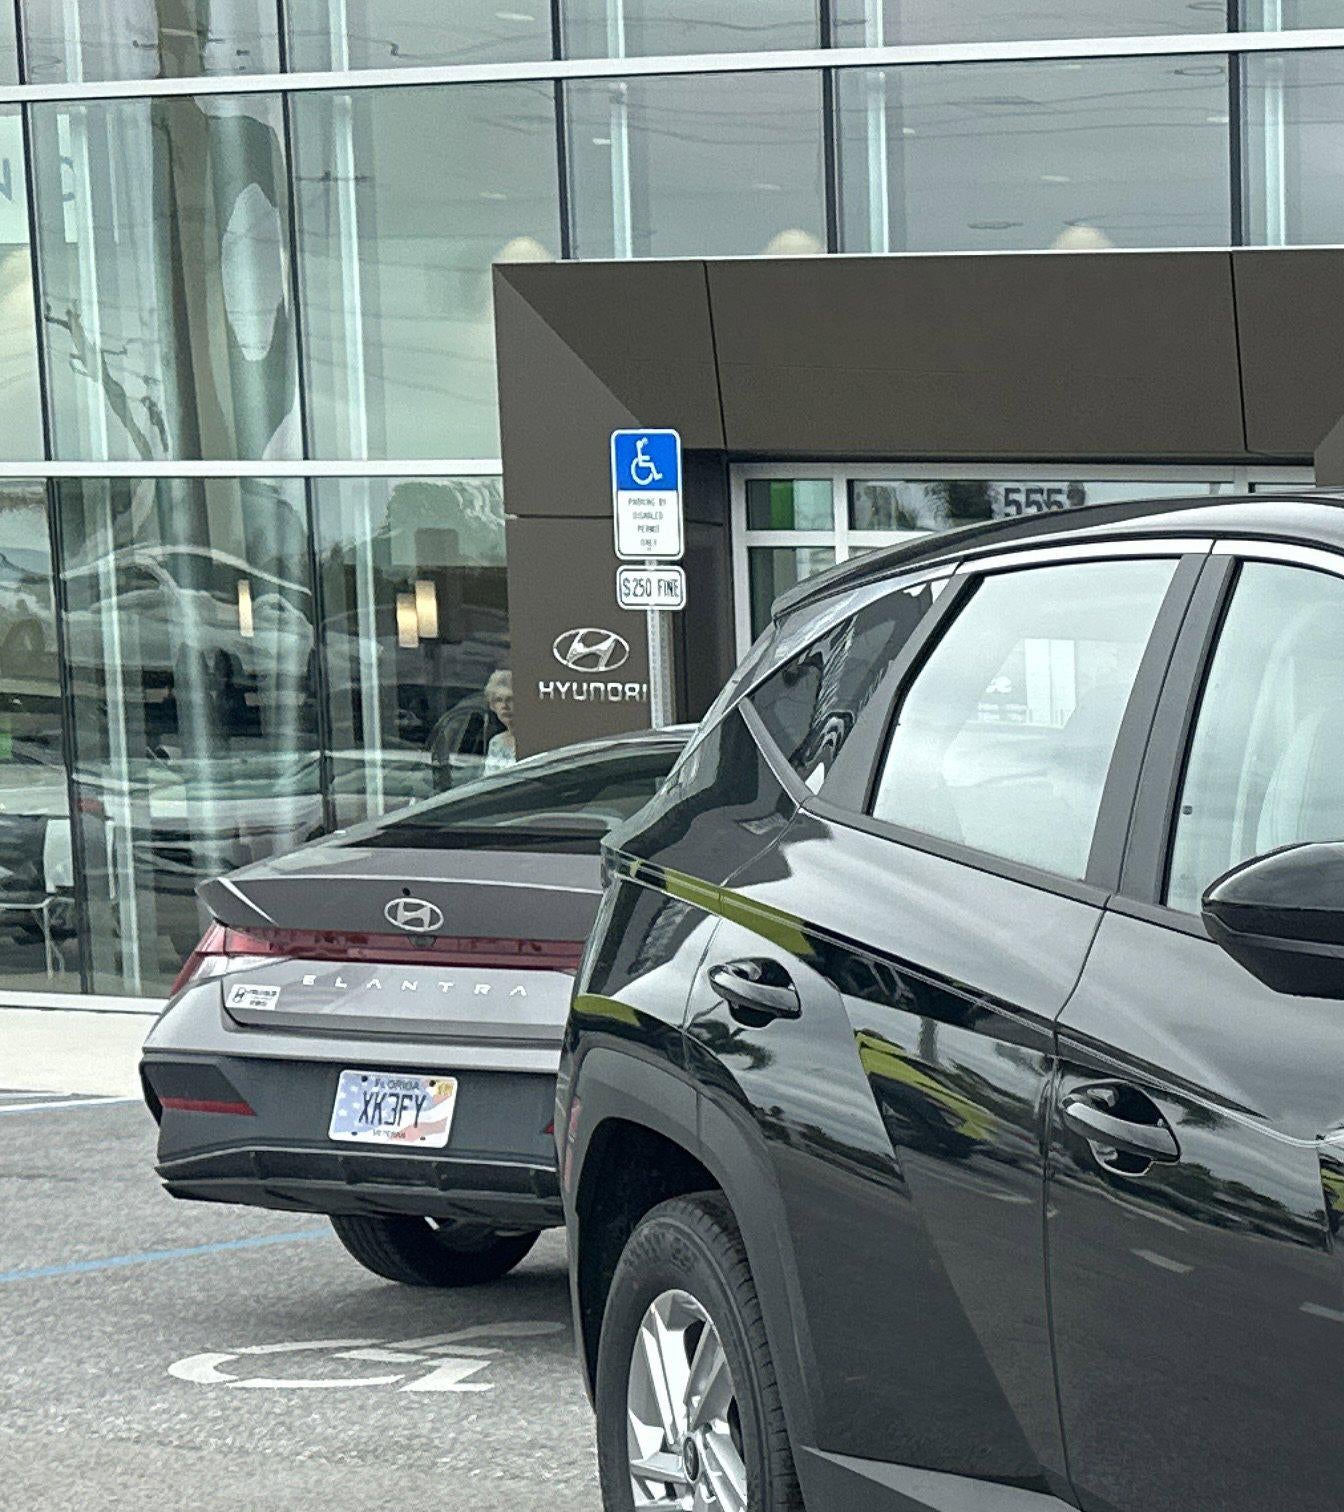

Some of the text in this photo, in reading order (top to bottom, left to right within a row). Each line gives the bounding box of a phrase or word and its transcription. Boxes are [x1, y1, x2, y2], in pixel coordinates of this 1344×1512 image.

[622, 577, 680, 598] $250 FINE
[538, 681, 648, 701] HYUNDAI
[302, 974, 527, 997] ELANTRA
[358, 1090, 427, 1129] XK3FY
